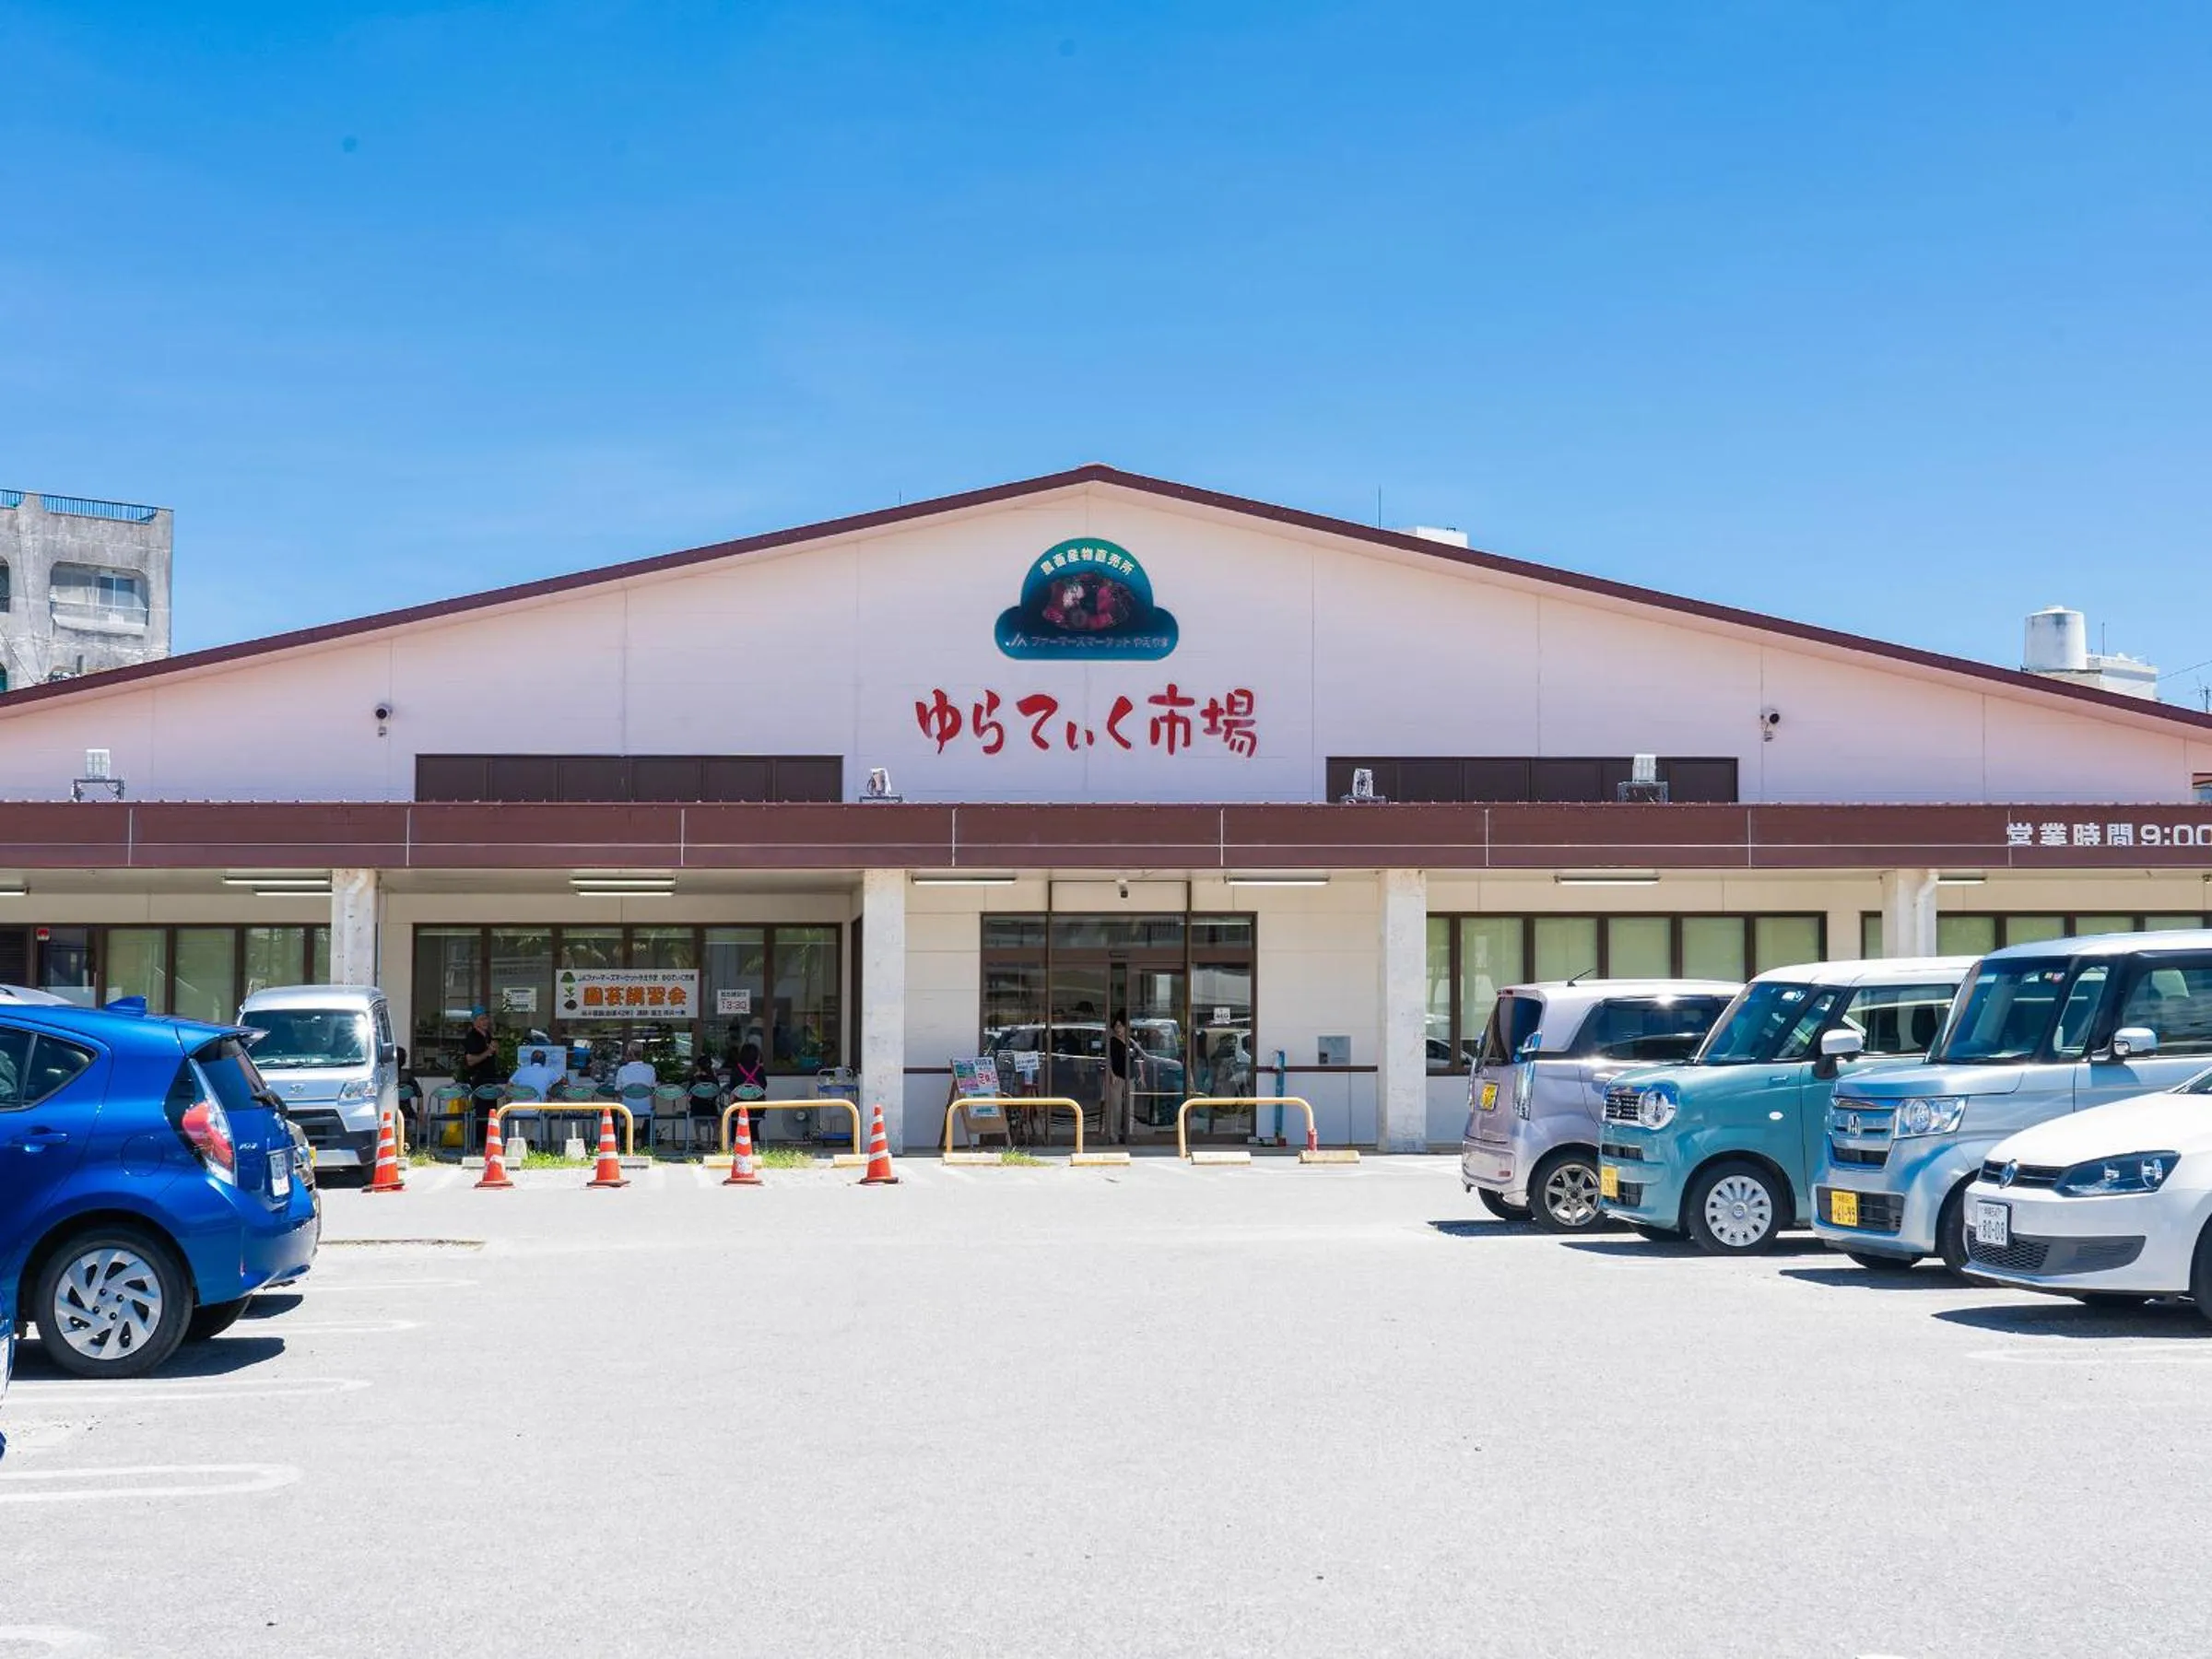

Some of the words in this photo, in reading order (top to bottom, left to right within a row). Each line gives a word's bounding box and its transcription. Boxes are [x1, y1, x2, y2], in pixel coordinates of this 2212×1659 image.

[914, 683, 1256, 758] ゆらてぃく市場
